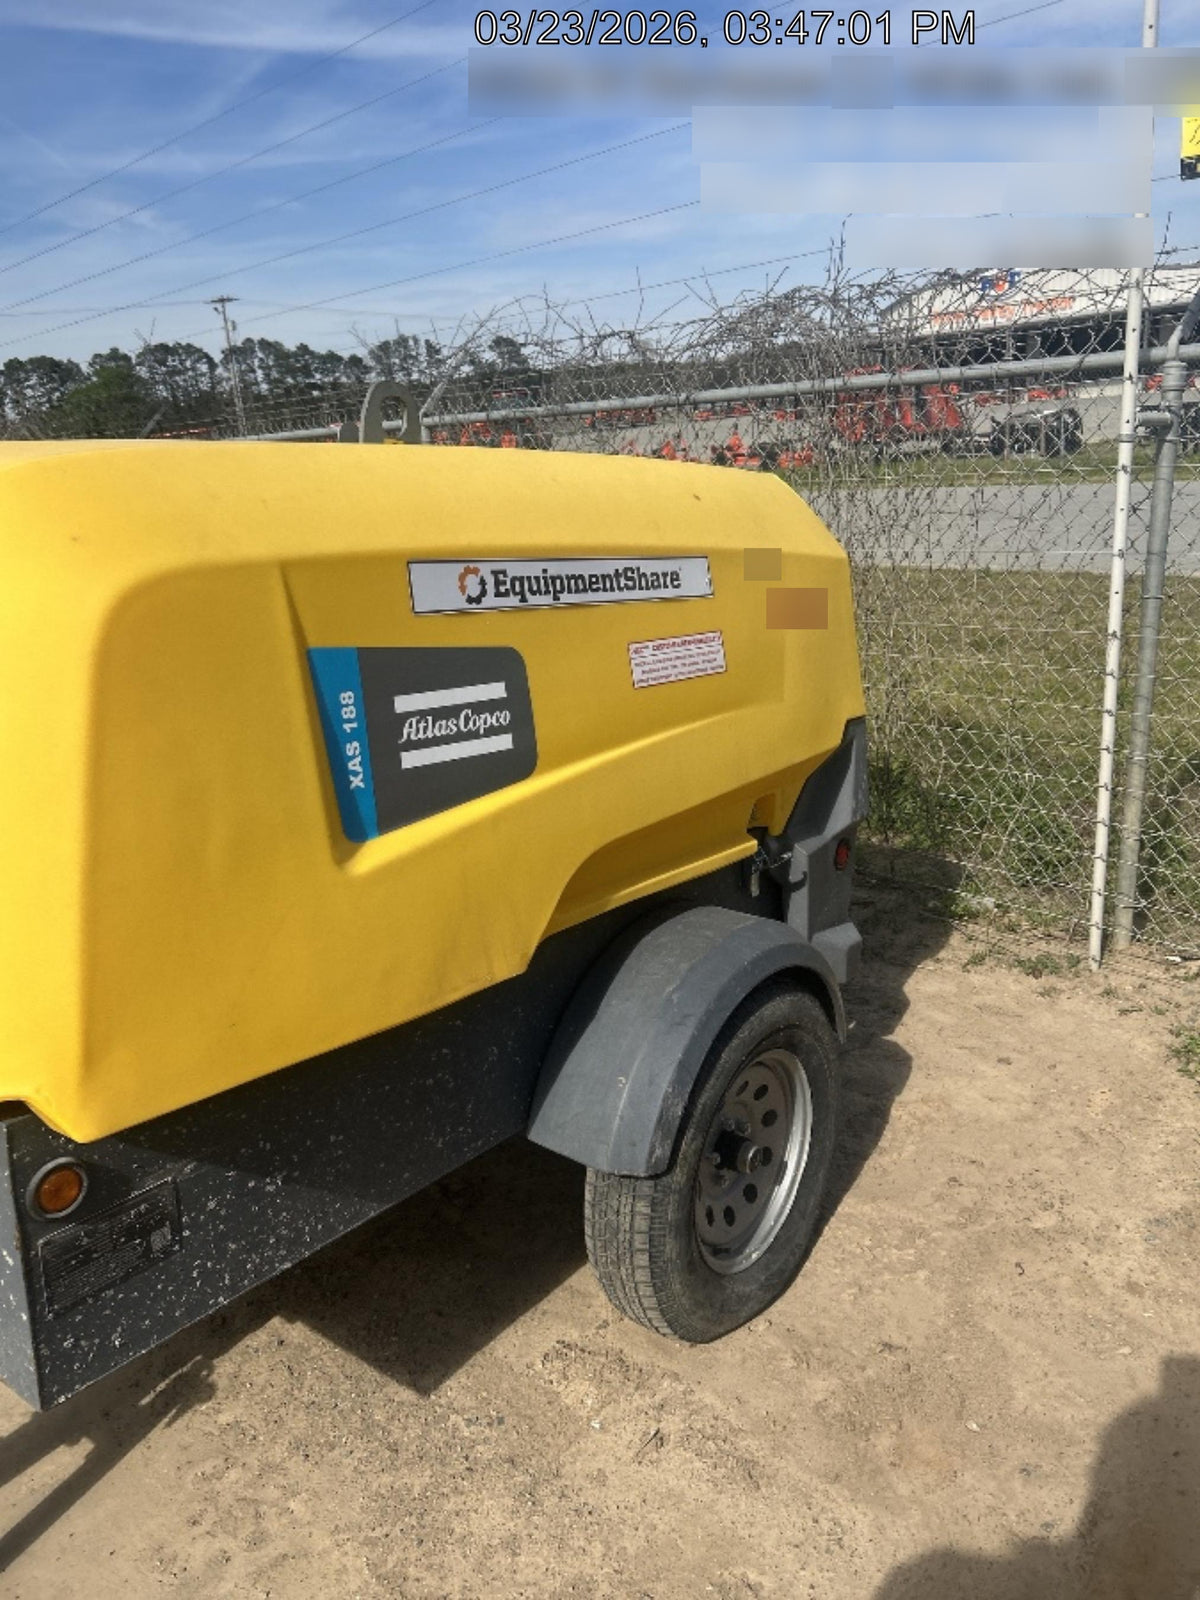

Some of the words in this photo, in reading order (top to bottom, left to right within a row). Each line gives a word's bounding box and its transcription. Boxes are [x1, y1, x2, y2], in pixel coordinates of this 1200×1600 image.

[490, 566, 682, 603] EquipmentShare
[339, 690, 358, 733] 188
[398, 715, 458, 744] Atlas
[459, 708, 511, 734] Copco
[346, 740, 365, 789] XAS
